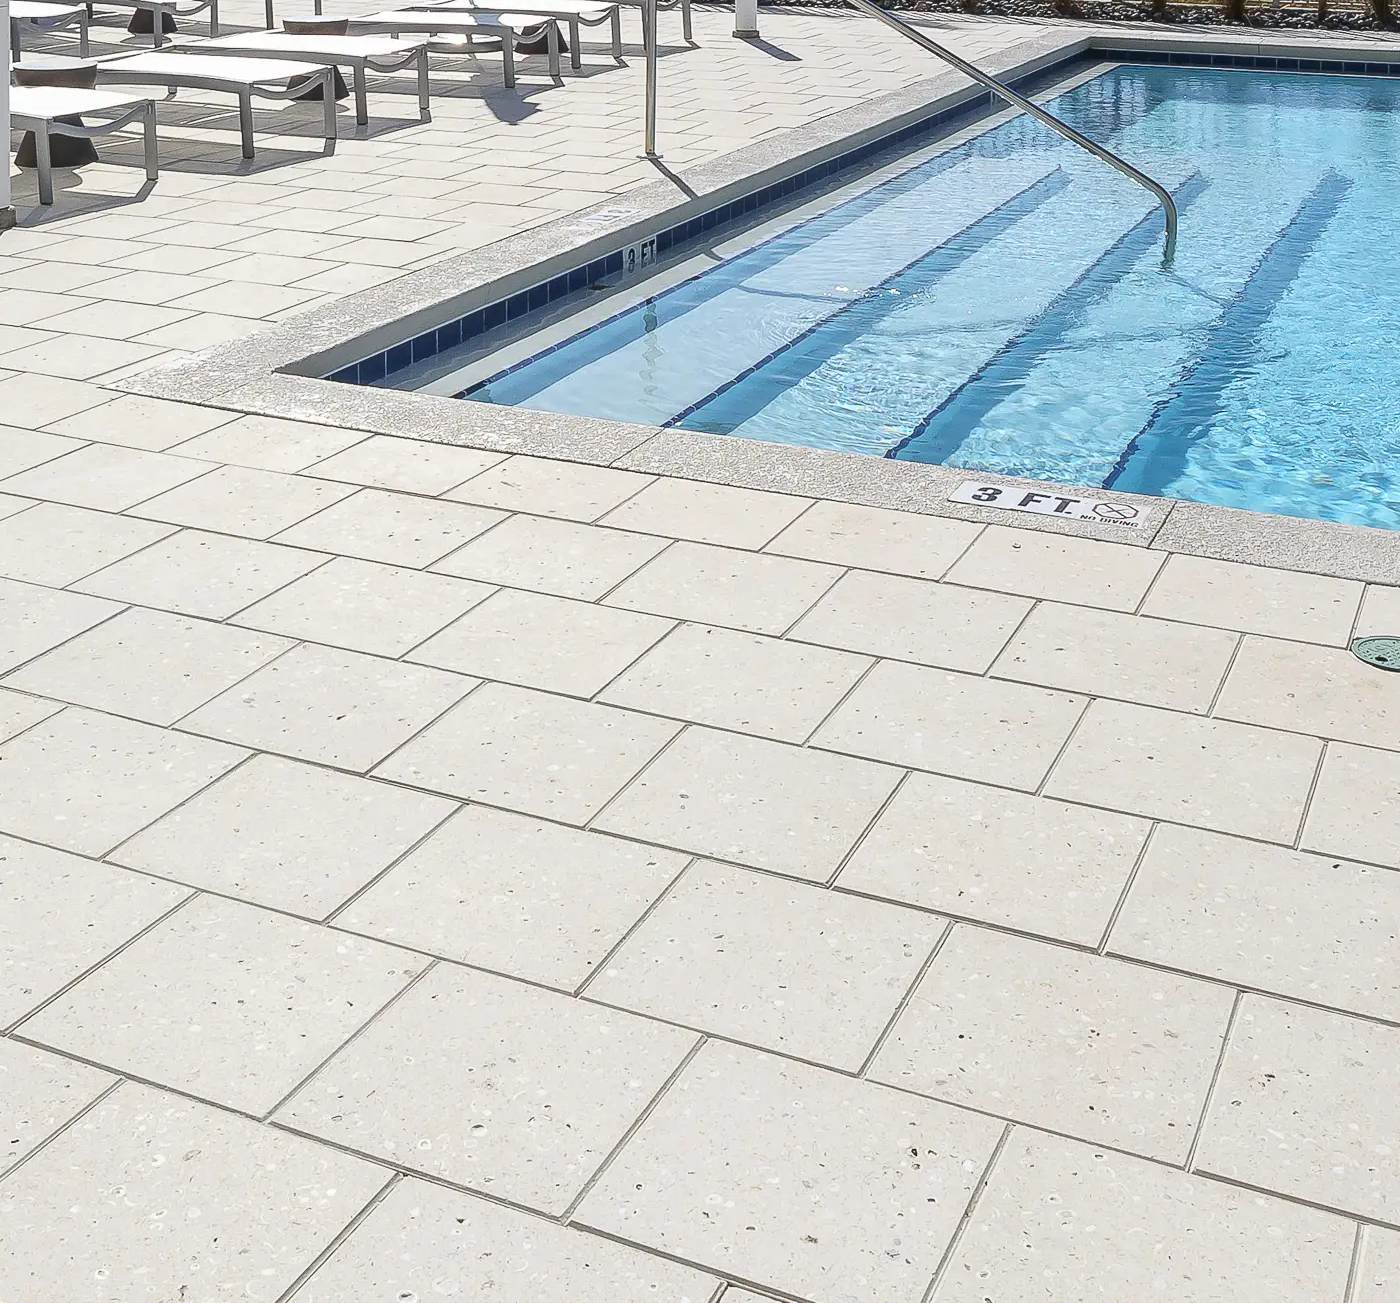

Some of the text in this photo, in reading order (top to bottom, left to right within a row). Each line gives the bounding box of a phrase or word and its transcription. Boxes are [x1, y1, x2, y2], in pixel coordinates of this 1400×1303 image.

[628, 248, 635, 273] 3
[971, 487, 1080, 514] 3 FT.
[1100, 518, 1139, 528] DIVING
